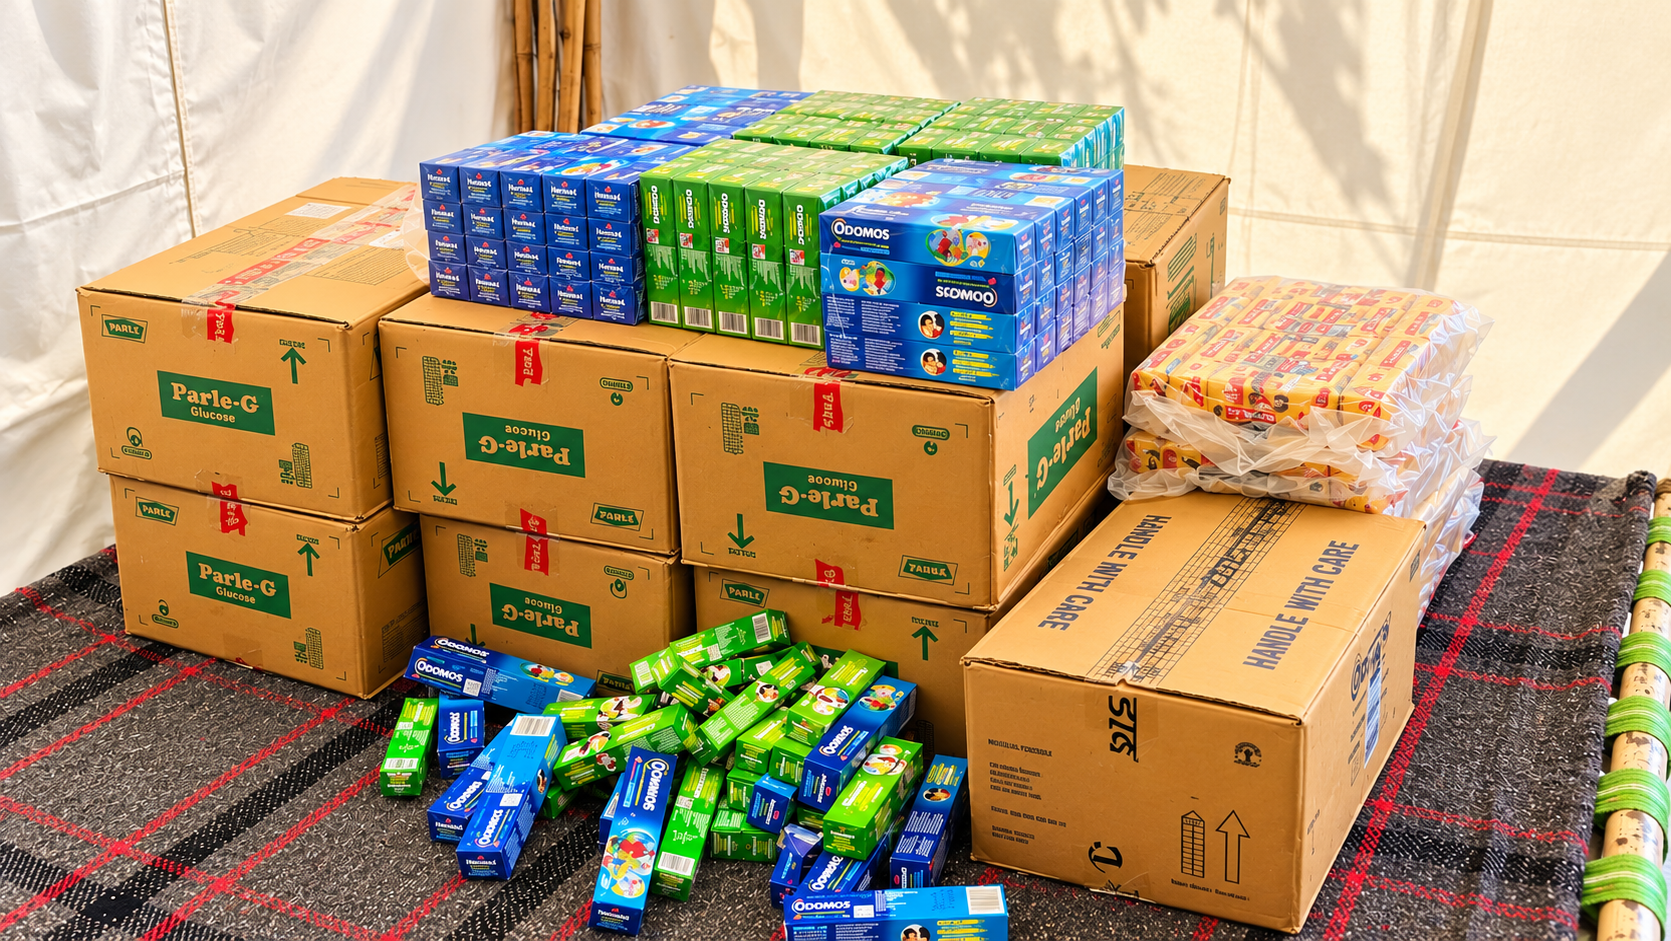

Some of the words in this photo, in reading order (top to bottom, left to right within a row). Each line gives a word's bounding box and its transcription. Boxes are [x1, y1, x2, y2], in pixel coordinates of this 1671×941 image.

[833, 222, 890, 240] ODOMOS
[108, 321, 140, 335] PARLE
[171, 382, 259, 414] Parle-G
[191, 407, 236, 423] Glucose
[478, 436, 571, 466] Parle-G
[779, 486, 879, 517] Parle-G
[198, 563, 277, 597] Parle-G
[216, 587, 256, 604] Glucose
[1242, 613, 1309, 670] HANDLE
[1284, 576, 1334, 611] WITH
[1311, 540, 1360, 575] CARE
[502, 604, 580, 637] Parle-G
[1038, 594, 1094, 631] CARE
[417, 661, 464, 683] ODOMOS
[795, 901, 851, 911] ODOMOS
